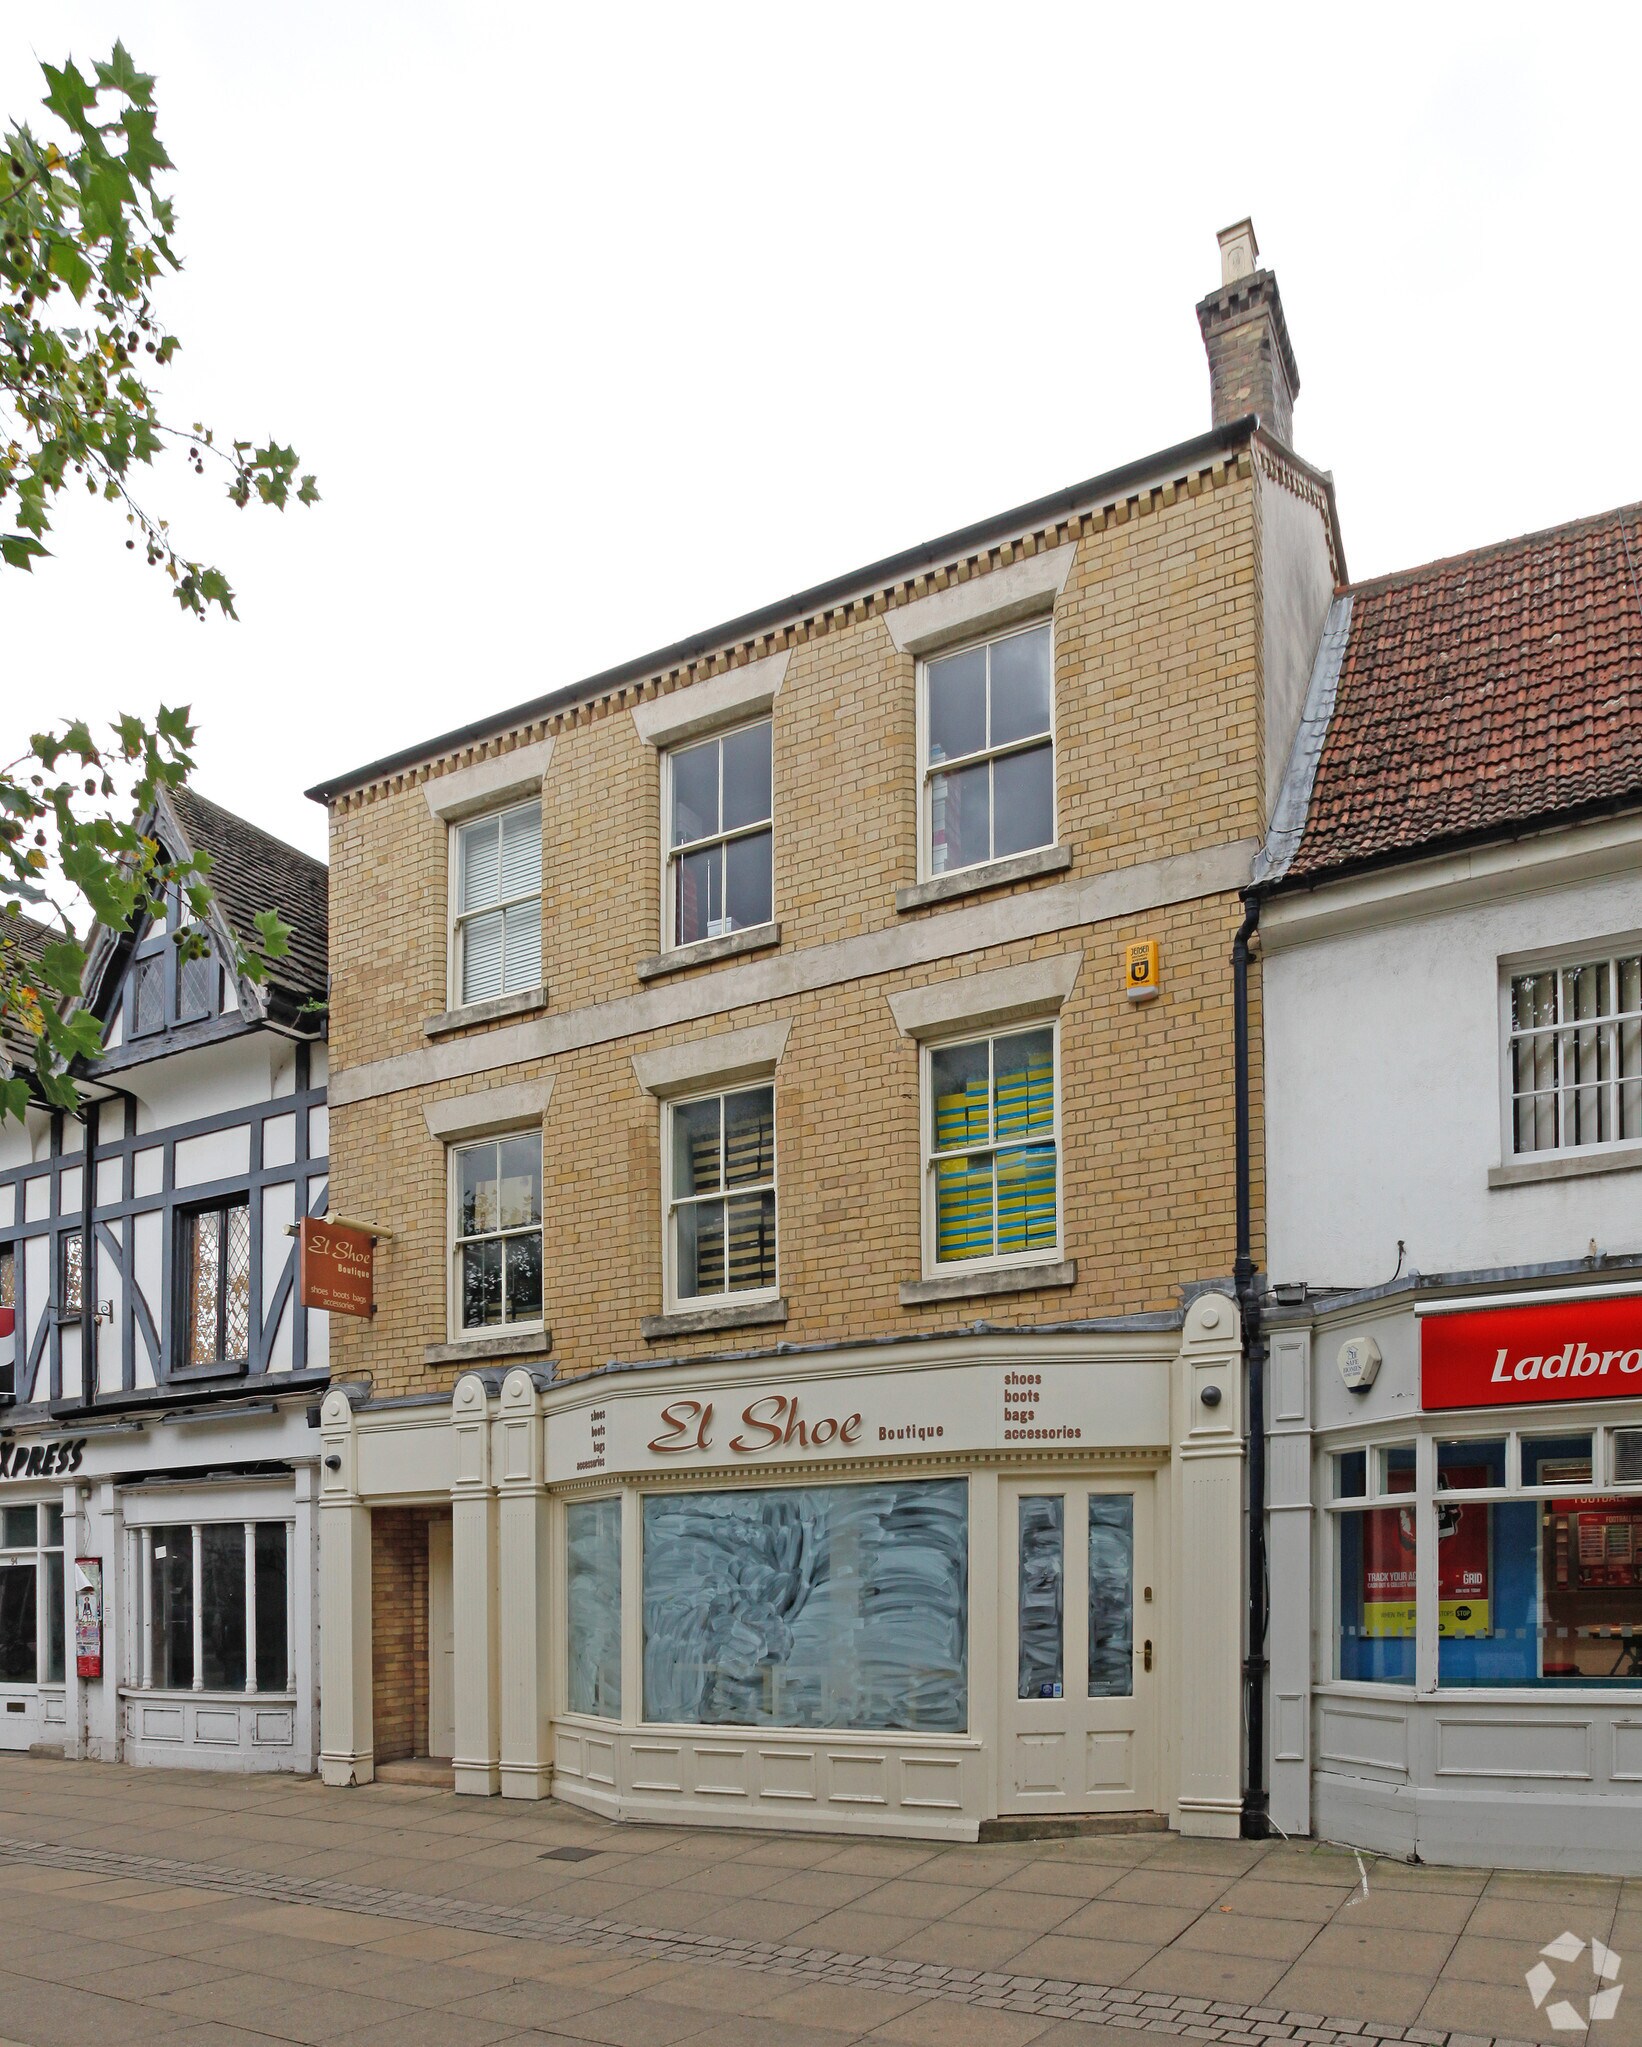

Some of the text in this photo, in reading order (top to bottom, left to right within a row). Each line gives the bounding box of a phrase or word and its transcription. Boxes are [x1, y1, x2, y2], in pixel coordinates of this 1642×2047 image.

[308, 1235, 370, 1264] El Shoe
[338, 1263, 370, 1278] Boutique
[311, 1285, 367, 1304] shoes boots bags
[323, 1299, 355, 1310] accessories
[1004, 1371, 1042, 1385] shoes
[1004, 1389, 1040, 1402] boots
[591, 1409, 606, 1421] shoes
[1004, 1407, 1035, 1424] bags
[647, 1395, 944, 1451] El Shoe Boutique
[591, 1425, 606, 1437] boots
[1004, 1425, 1082, 1440] accessories
[593, 1441, 605, 1454] bags
[576, 1455, 605, 1470] accessories
[1368, 1572, 1389, 1582] TRACK
[1390, 1571, 1407, 1581] YOUR
[1463, 1573, 1482, 1584] GRID
[1457, 1609, 1471, 1617] STOP
